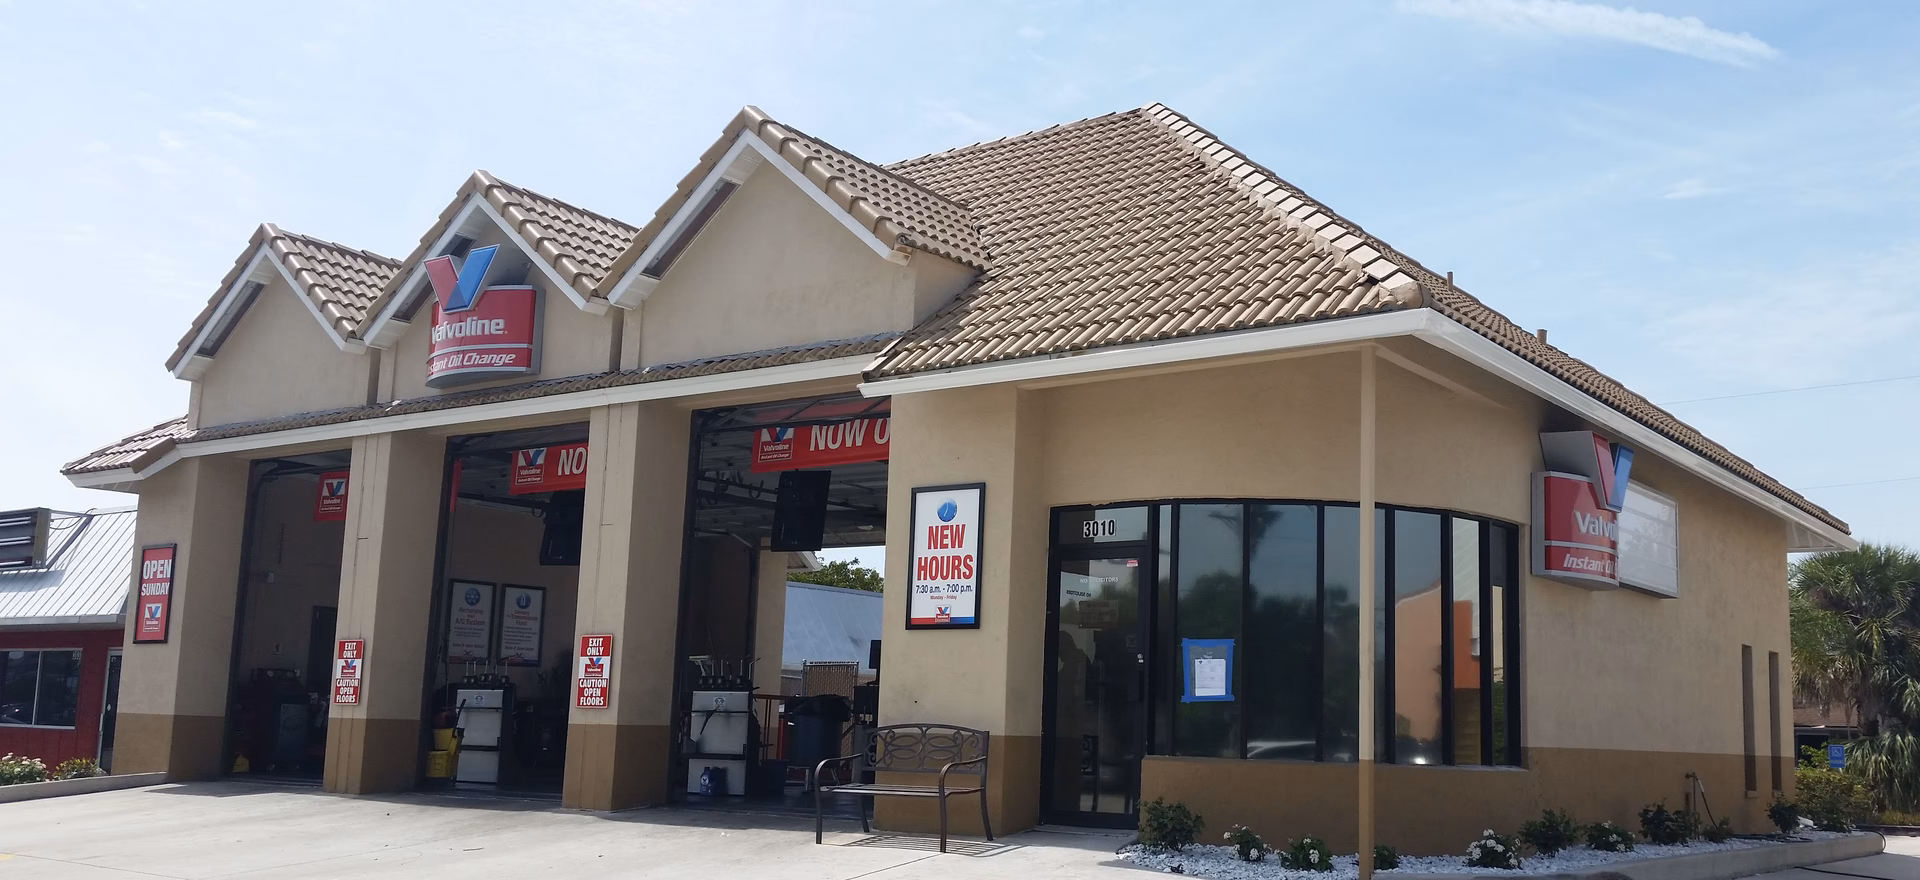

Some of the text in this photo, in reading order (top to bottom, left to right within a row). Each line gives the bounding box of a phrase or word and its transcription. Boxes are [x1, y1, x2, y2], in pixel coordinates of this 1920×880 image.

[431, 316, 505, 344] Valvoline
[429, 352, 517, 374] stant Oil Change
[809, 418, 870, 451] NOW
[557, 447, 587, 476] NO
[1084, 519, 1115, 537] 3010
[927, 524, 966, 550] NEW
[917, 554, 974, 581] HOURS
[1563, 553, 1605, 573] Instant
[143, 559, 172, 580] OPEN
[141, 582, 170, 596] SUNDAY
[916, 584, 928, 594] 7:30
[946, 583, 959, 593] 7:00
[345, 642, 357, 650] EXIT
[588, 638, 604, 647] EXIT
[343, 650, 357, 659] ONLY
[586, 647, 604, 656] ONLY
[336, 679, 359, 687] CAUTION
[579, 679, 607, 688] CAUTION
[340, 687, 354, 695] OPEN
[584, 688, 601, 697] OPEN
[336, 694, 356, 703] FLOORS
[580, 697, 604, 706] FLOORS
